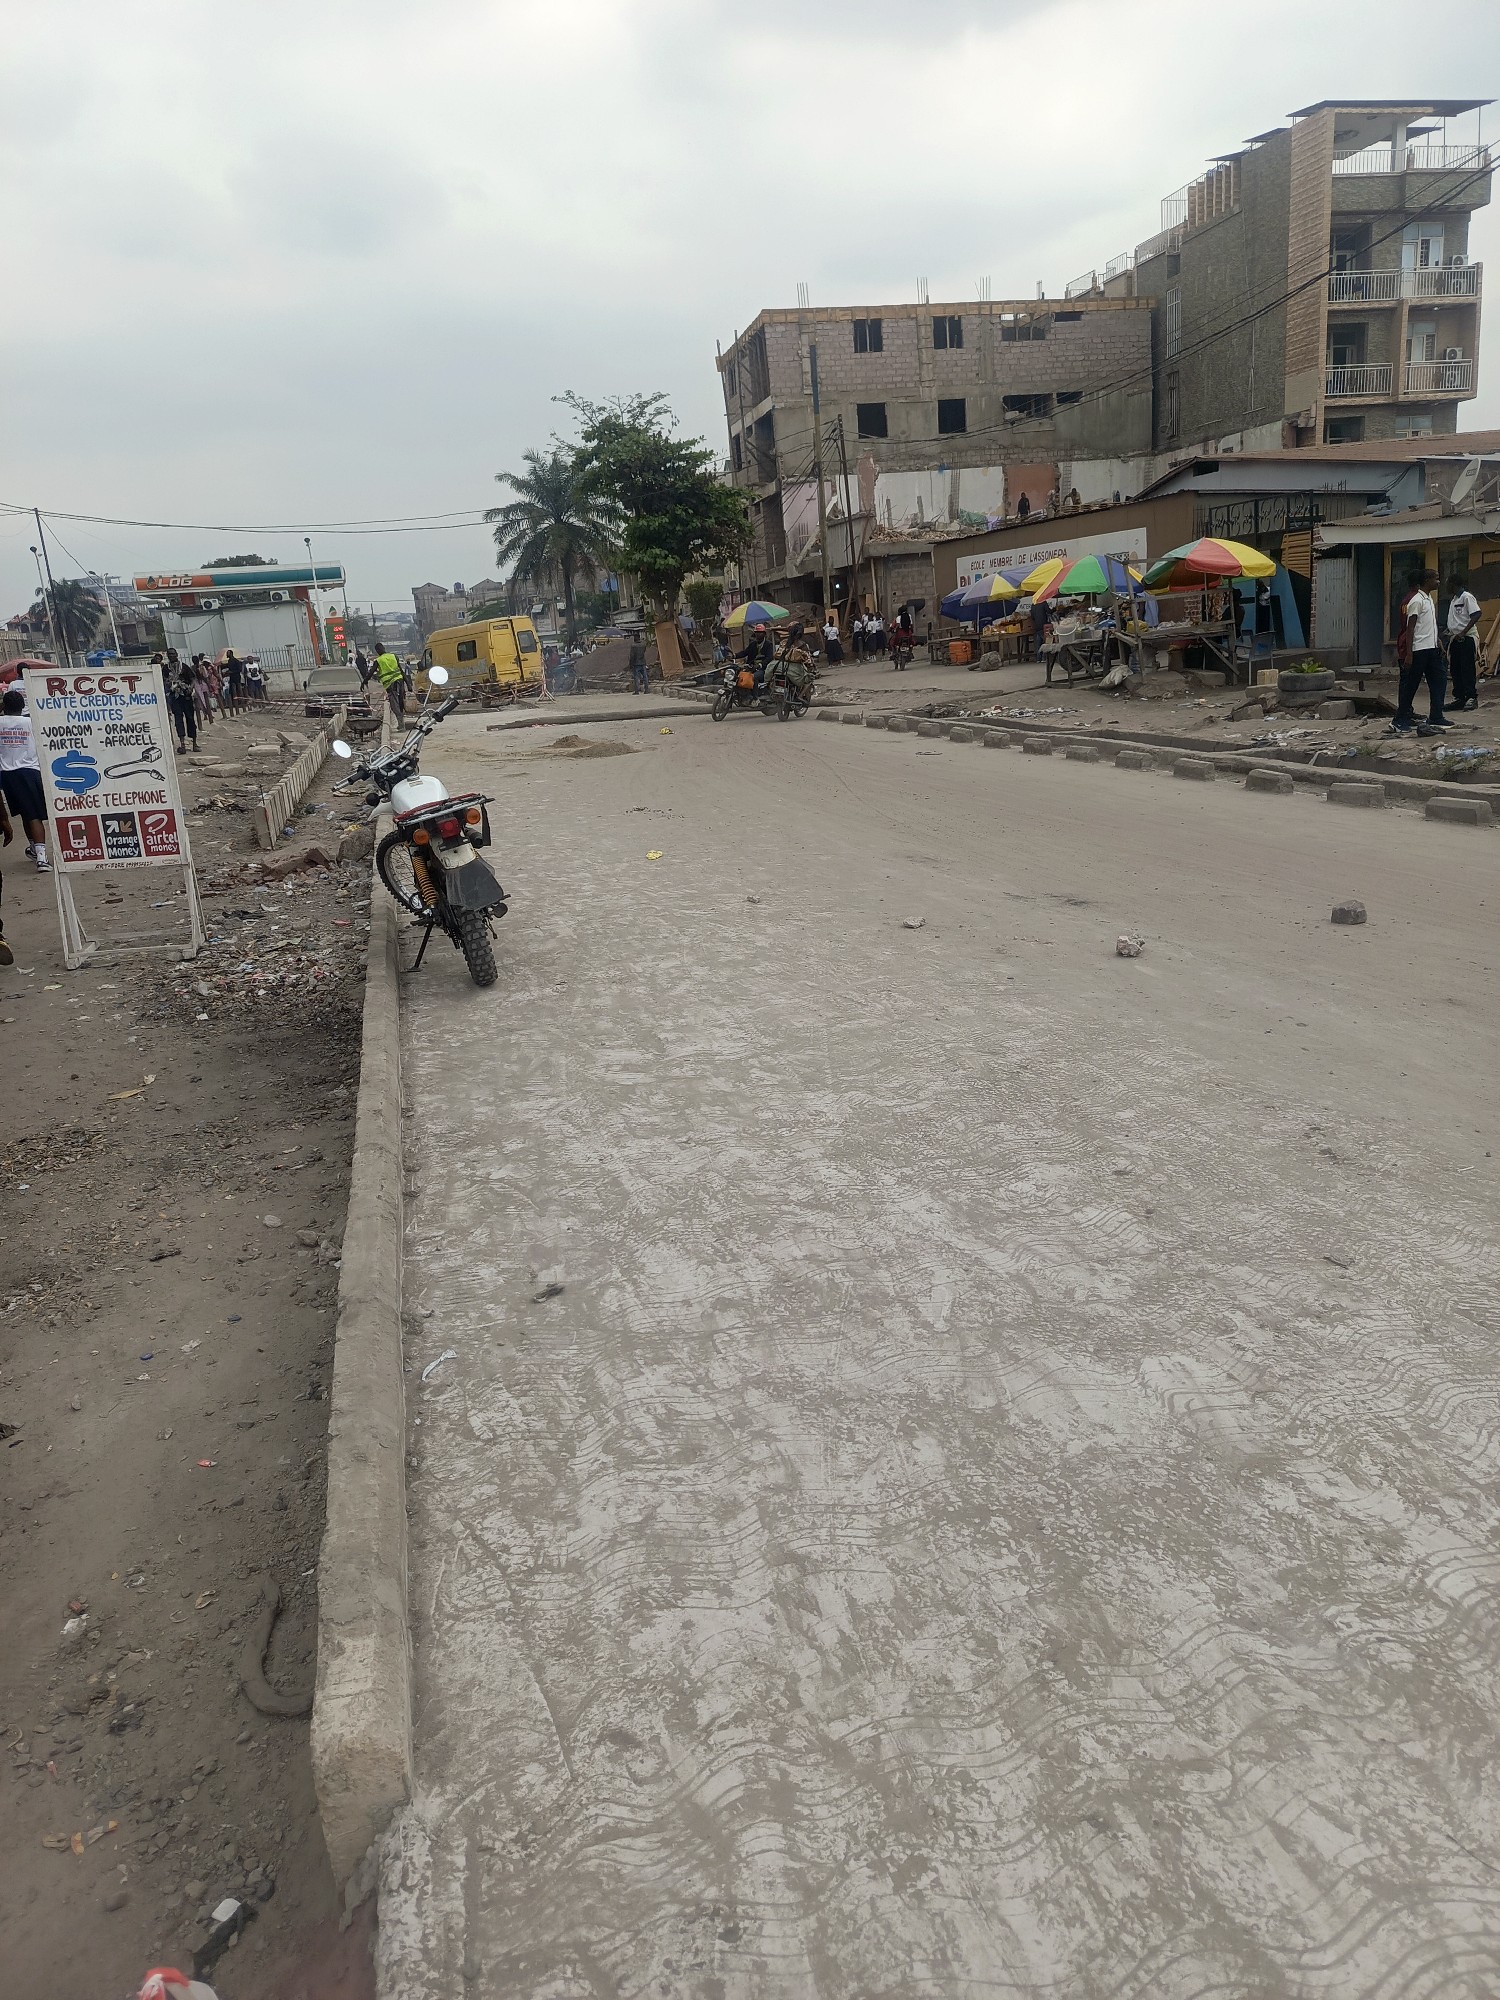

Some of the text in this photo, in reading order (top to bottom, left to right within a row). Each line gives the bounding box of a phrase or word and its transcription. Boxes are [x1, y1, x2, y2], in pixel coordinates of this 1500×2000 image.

[970, 560, 985, 571] ECOLE
[989, 556, 1013, 568] MEMBRE
[1018, 554, 1027, 565] DE
[36, 696, 78, 710] VENTE
[129, 693, 158, 705] MEGA
[66, 708, 124, 723] MINUTES
[54, 789, 168, 812] CHARGE TELEPHONE
[146, 830, 179, 846] airtel
[62, 848, 102, 860] m-pesa
[108, 846, 139, 858] Money
[150, 844, 178, 853] money
